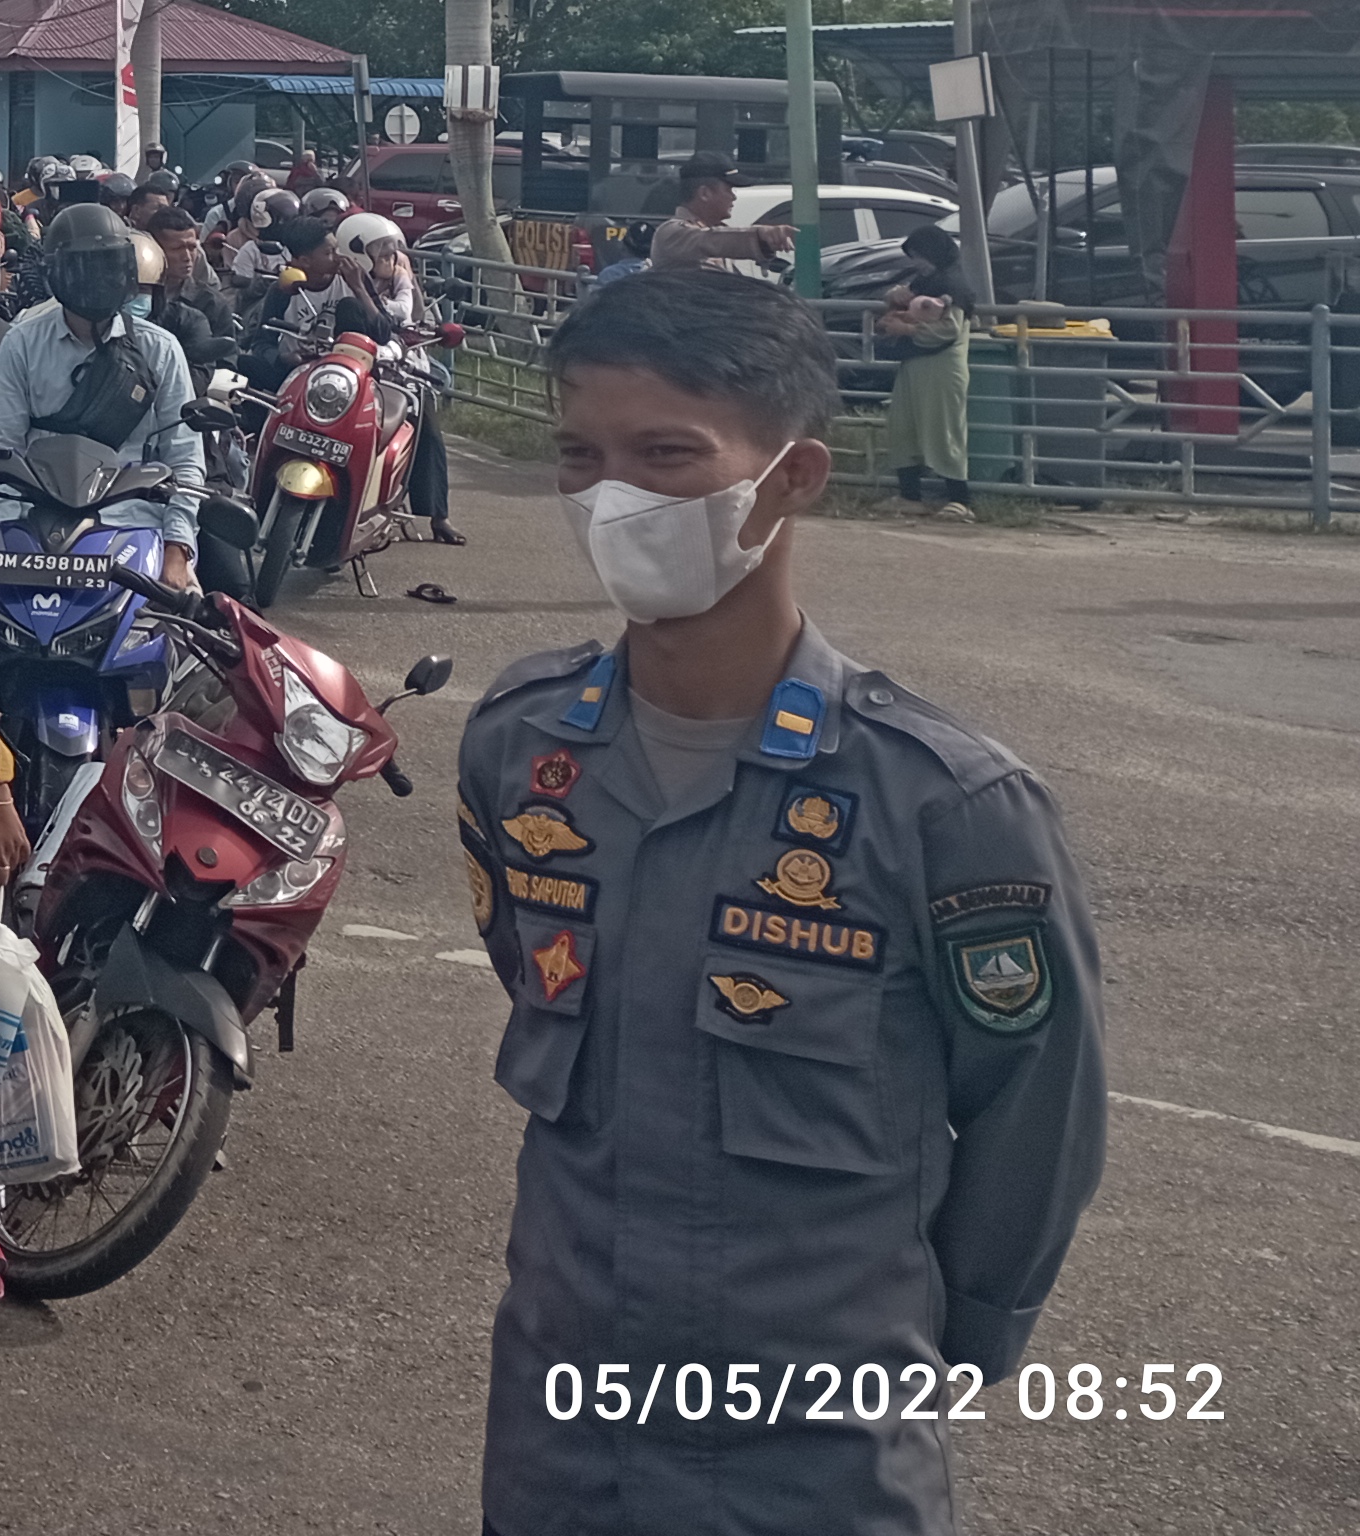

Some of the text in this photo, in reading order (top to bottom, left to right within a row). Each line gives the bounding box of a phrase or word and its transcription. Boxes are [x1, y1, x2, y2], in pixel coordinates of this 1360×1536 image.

[21, 554, 69, 571] 4598
[72, 557, 108, 573] DAN
[530, 874, 586, 910] SAPUTRA
[723, 905, 875, 960] DISHUB
